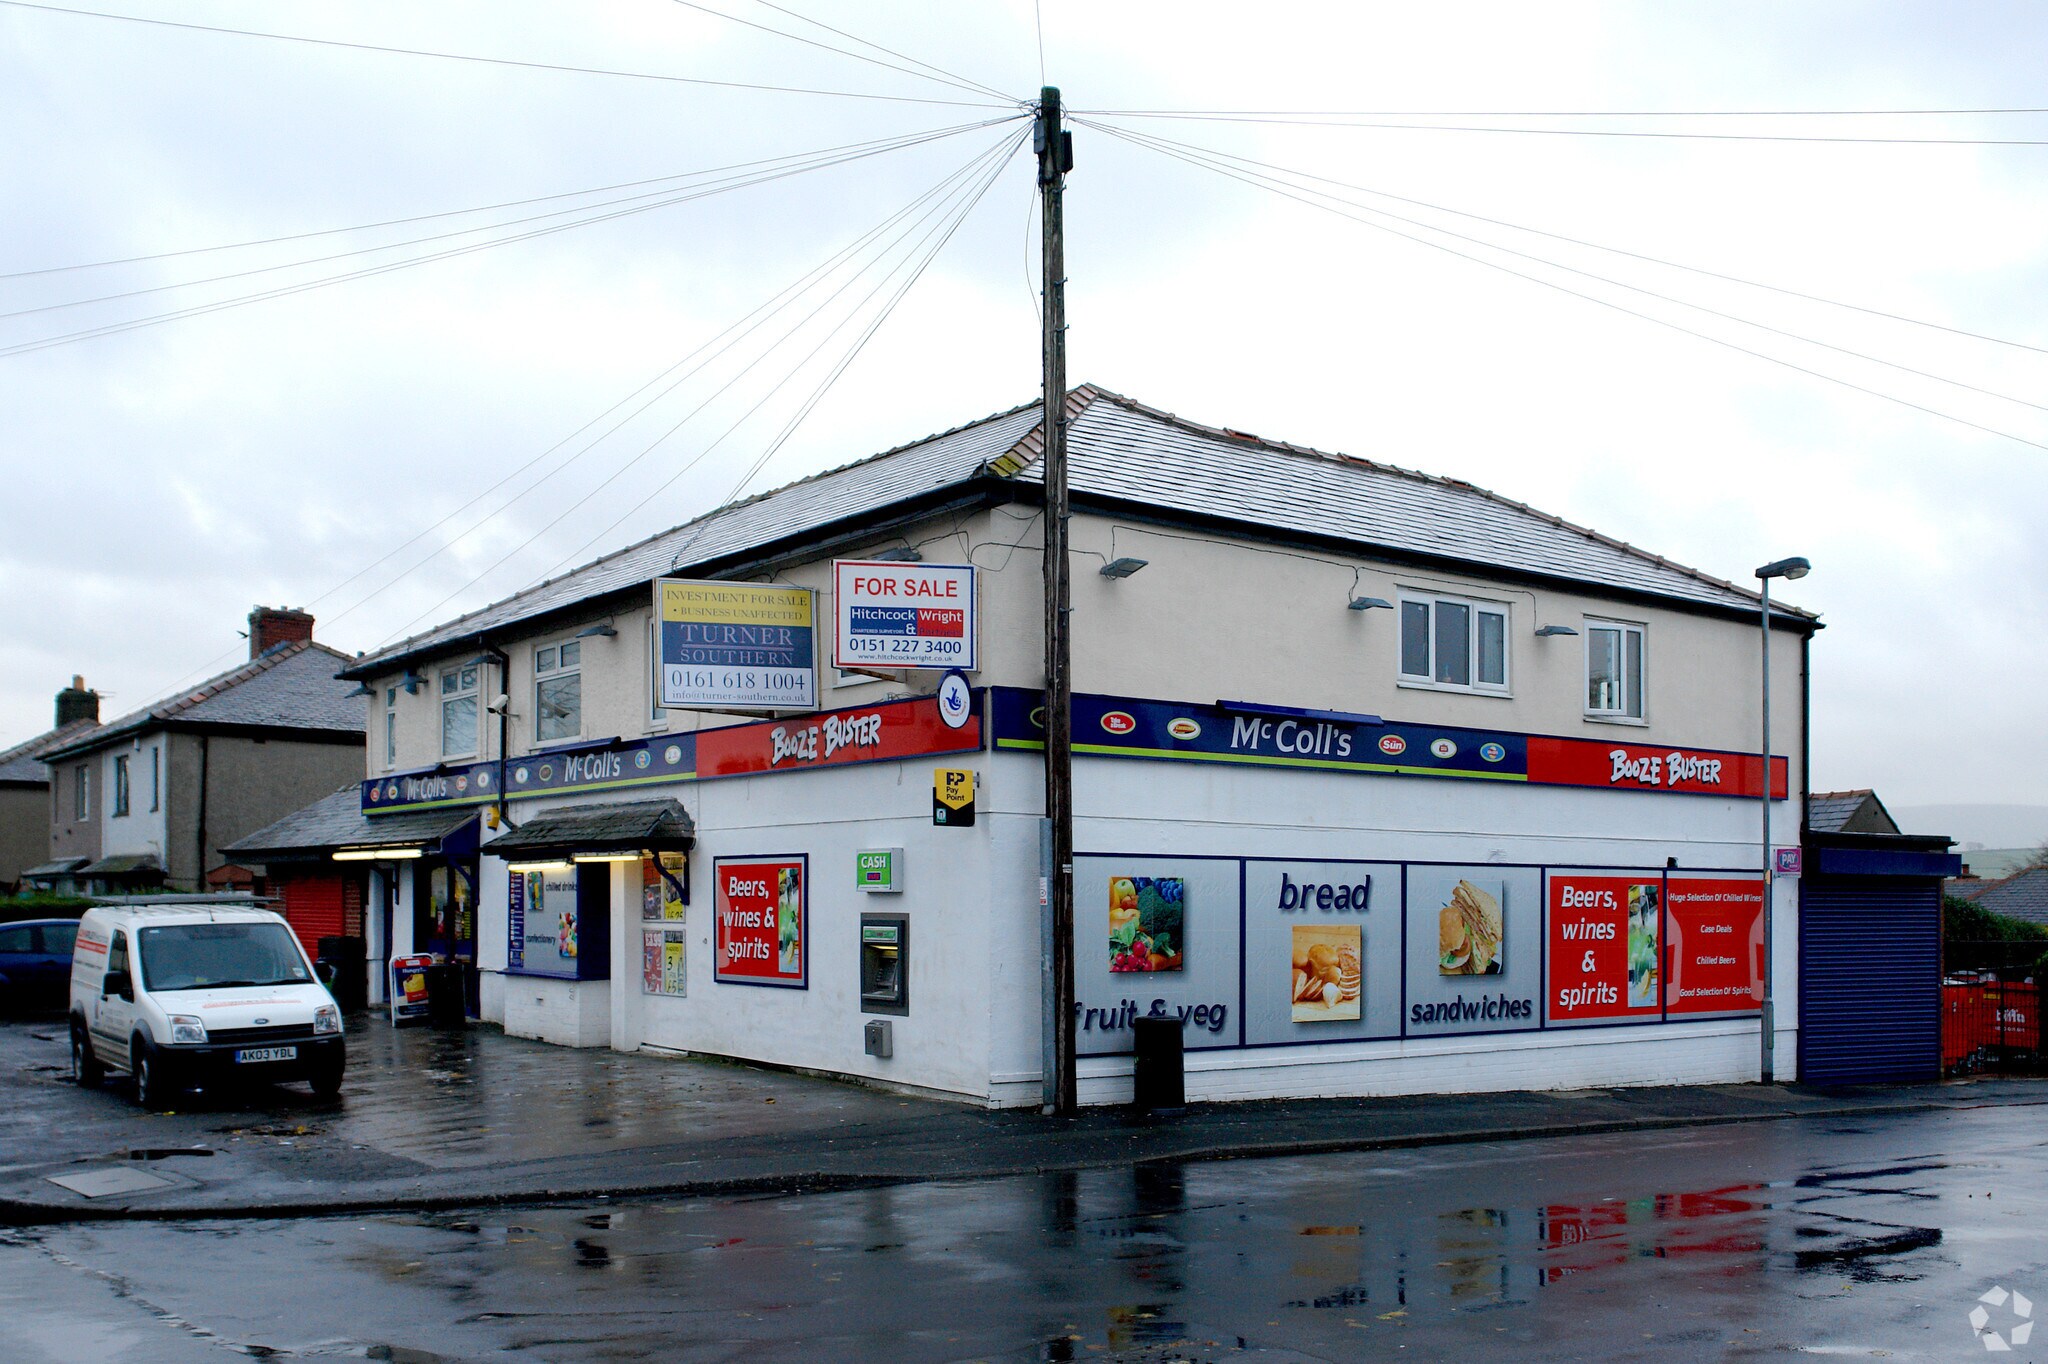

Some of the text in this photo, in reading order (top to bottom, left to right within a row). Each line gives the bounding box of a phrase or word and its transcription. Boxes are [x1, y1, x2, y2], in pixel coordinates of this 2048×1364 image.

[854, 577, 958, 597] FOR SALE
[667, 590, 807, 606] INVESTMENT FOR SALE
[681, 607, 802, 620] BUSINESS UNAFFECTED
[851, 608, 962, 624] Hitchcock Wright
[681, 624, 793, 645] TURNER
[905, 623, 917, 635] &
[850, 638, 962, 654] 0151 227 3400
[681, 649, 793, 665] SOUTHERN
[858, 654, 953, 662] www.hitchcockwright.co.uk
[672, 670, 805, 690] 0161 618 1004
[672, 691, 806, 702] info@turner-southern.co.uk
[771, 713, 881, 765] BOOZE BUSTER
[1230, 716, 1352, 757] McColl's
[564, 751, 621, 782] McColl's
[1610, 749, 1721, 786] BOOZE BUSTER
[407, 775, 447, 800] McColl's
[946, 786, 959, 795] Pay
[861, 856, 886, 868] CASH
[1782, 854, 1796, 865] PAY
[728, 876, 769, 899] Beers,
[1278, 872, 1371, 910] bread
[1561, 885, 1617, 910] Beers,
[1669, 893, 1762, 902] Huge Selection Of Chilled Wines
[722, 906, 775, 928] wines &
[1562, 917, 1616, 940] wines
[1700, 925, 1733, 933] Case Deals
[525, 934, 556, 946] confectionery
[728, 937, 770, 963] spirits
[1581, 950, 1596, 973] &
[1696, 956, 1736, 965] Chilled Beers
[1559, 981, 1618, 1011] spirits
[1680, 986, 1752, 996] Good Selection Of Spirits
[1177, 1003, 1226, 1032] veg
[1410, 993, 1532, 1023] sandwiches
[241, 1048, 294, 1061] AK03 YDL
